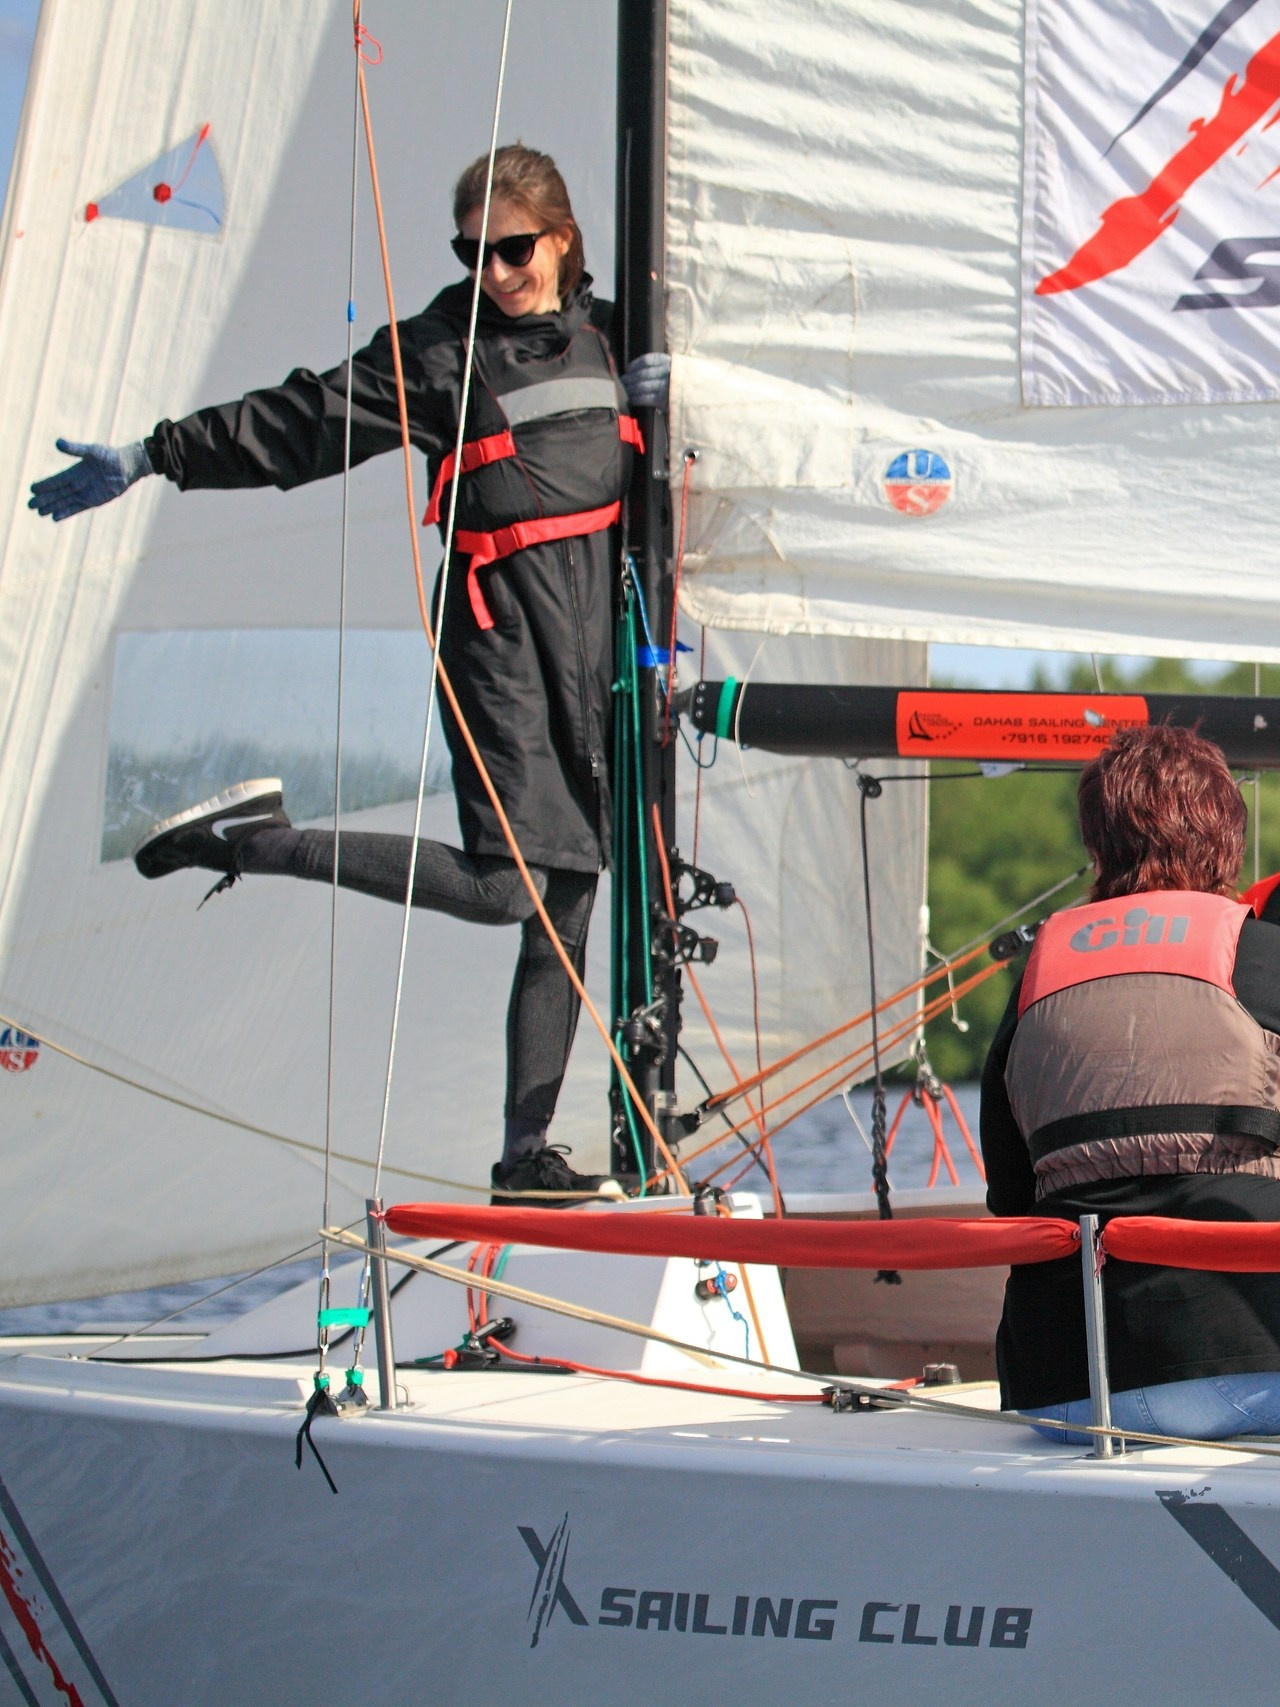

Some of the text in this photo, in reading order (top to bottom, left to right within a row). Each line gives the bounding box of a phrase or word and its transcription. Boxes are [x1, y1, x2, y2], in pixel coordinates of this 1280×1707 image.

[973, 717, 1023, 726] DAHAB
[1029, 718, 1085, 728] SAILING
[1070, 907, 1190, 952] Gill
[598, 1586, 839, 1641] SAILING
[858, 1601, 1034, 1649] CLUB
